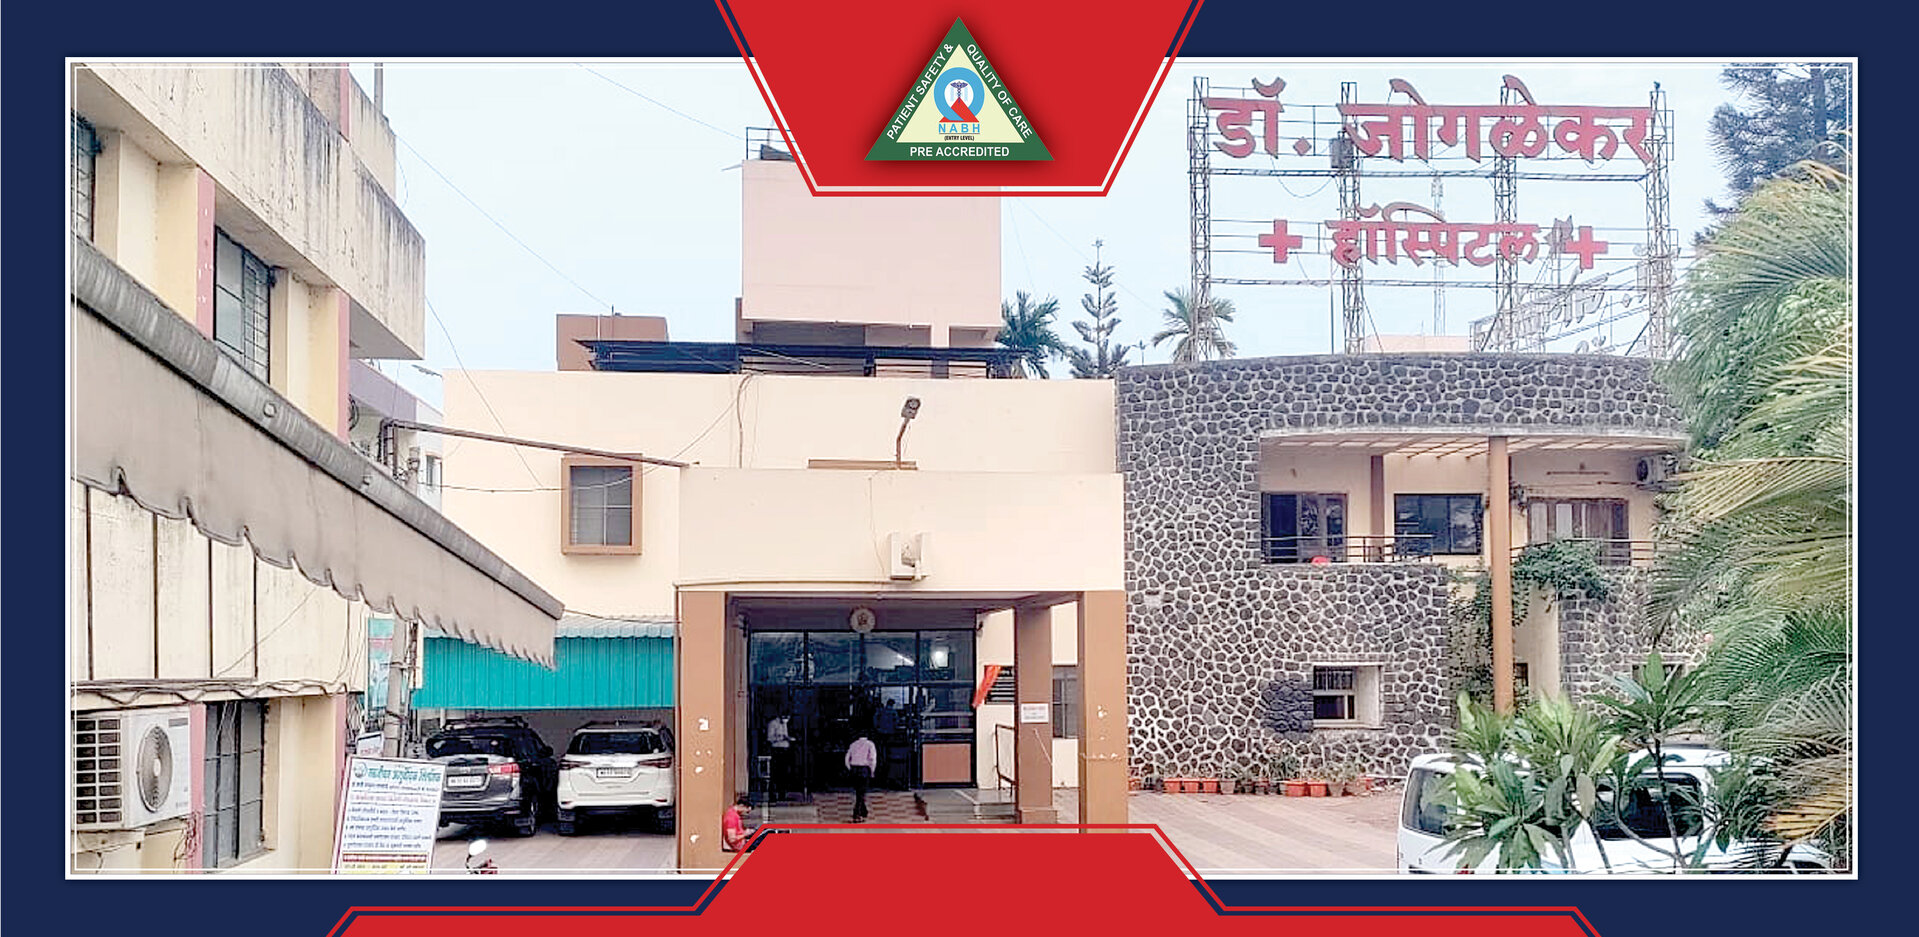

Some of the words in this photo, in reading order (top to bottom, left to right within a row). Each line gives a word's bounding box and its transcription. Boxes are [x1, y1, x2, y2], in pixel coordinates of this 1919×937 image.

[1203, 77, 1312, 159] डॉ.
[1337, 75, 1655, 164] जोगळेकर
[1325, 201, 1541, 268] हॉस्पिटल
